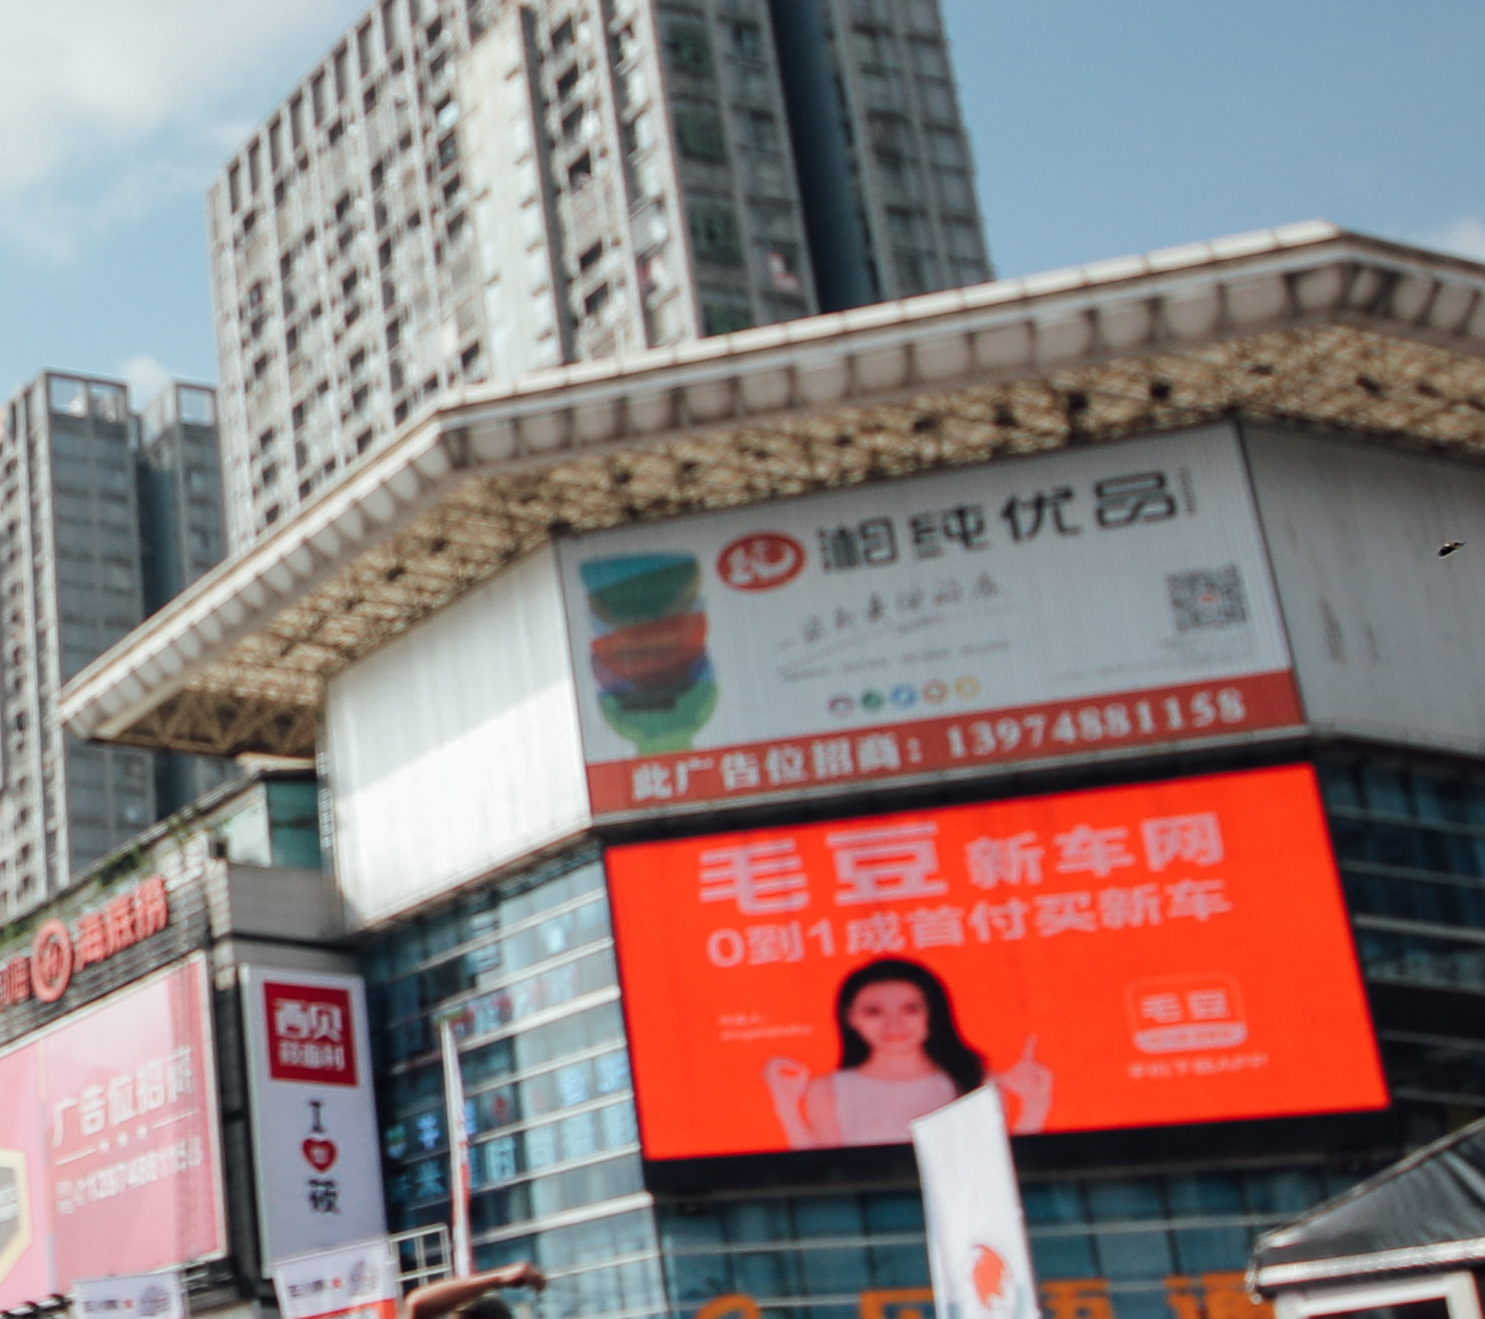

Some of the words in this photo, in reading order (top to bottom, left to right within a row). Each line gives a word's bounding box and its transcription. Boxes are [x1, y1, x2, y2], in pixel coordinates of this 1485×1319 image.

[947, 688, 1247, 760] 13974881158
[699, 822, 948, 916] 毛豆
[965, 812, 1225, 889] 新车网
[707, 879, 1232, 967] 0到1成首付买新车
[1141, 988, 1231, 1023] 毛豆
